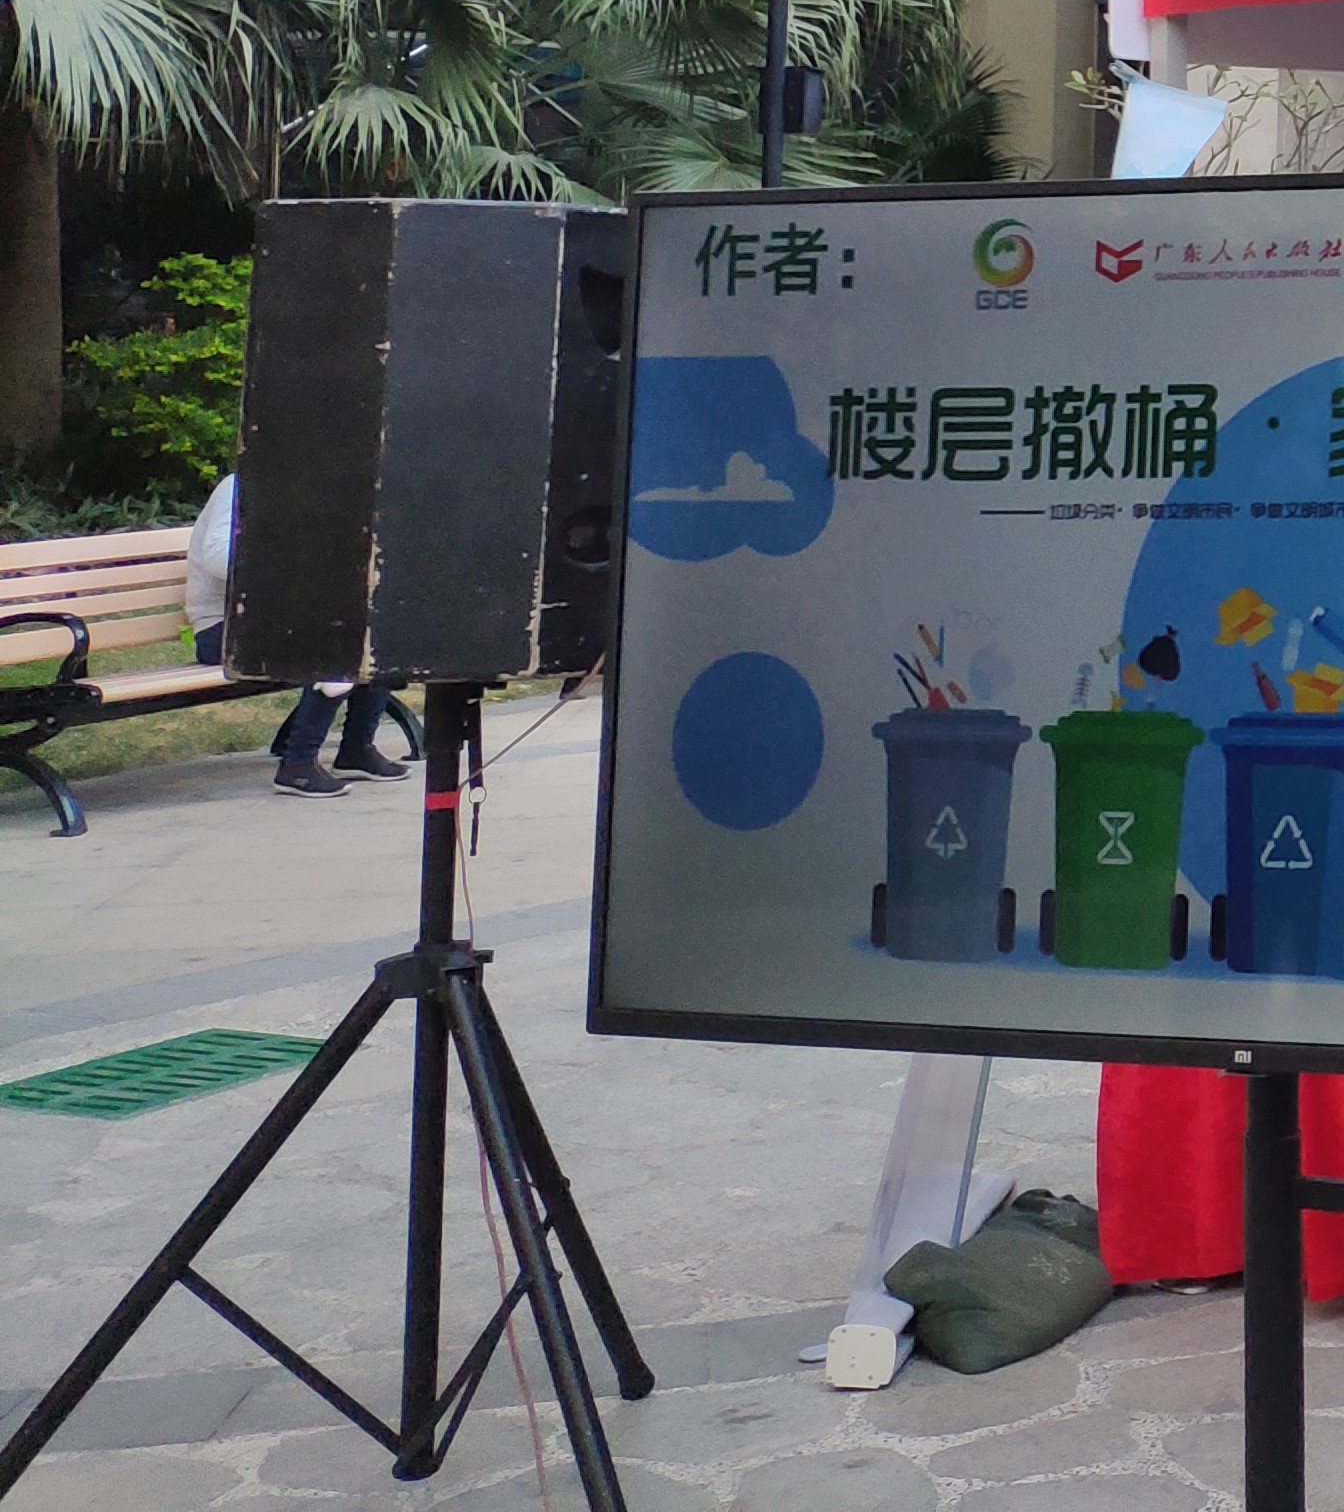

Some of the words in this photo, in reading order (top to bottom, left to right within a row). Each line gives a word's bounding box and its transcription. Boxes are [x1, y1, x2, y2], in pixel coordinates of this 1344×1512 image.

[975, 289, 1029, 310] GCE
[826, 384, 1219, 481] 楼层撤桶
